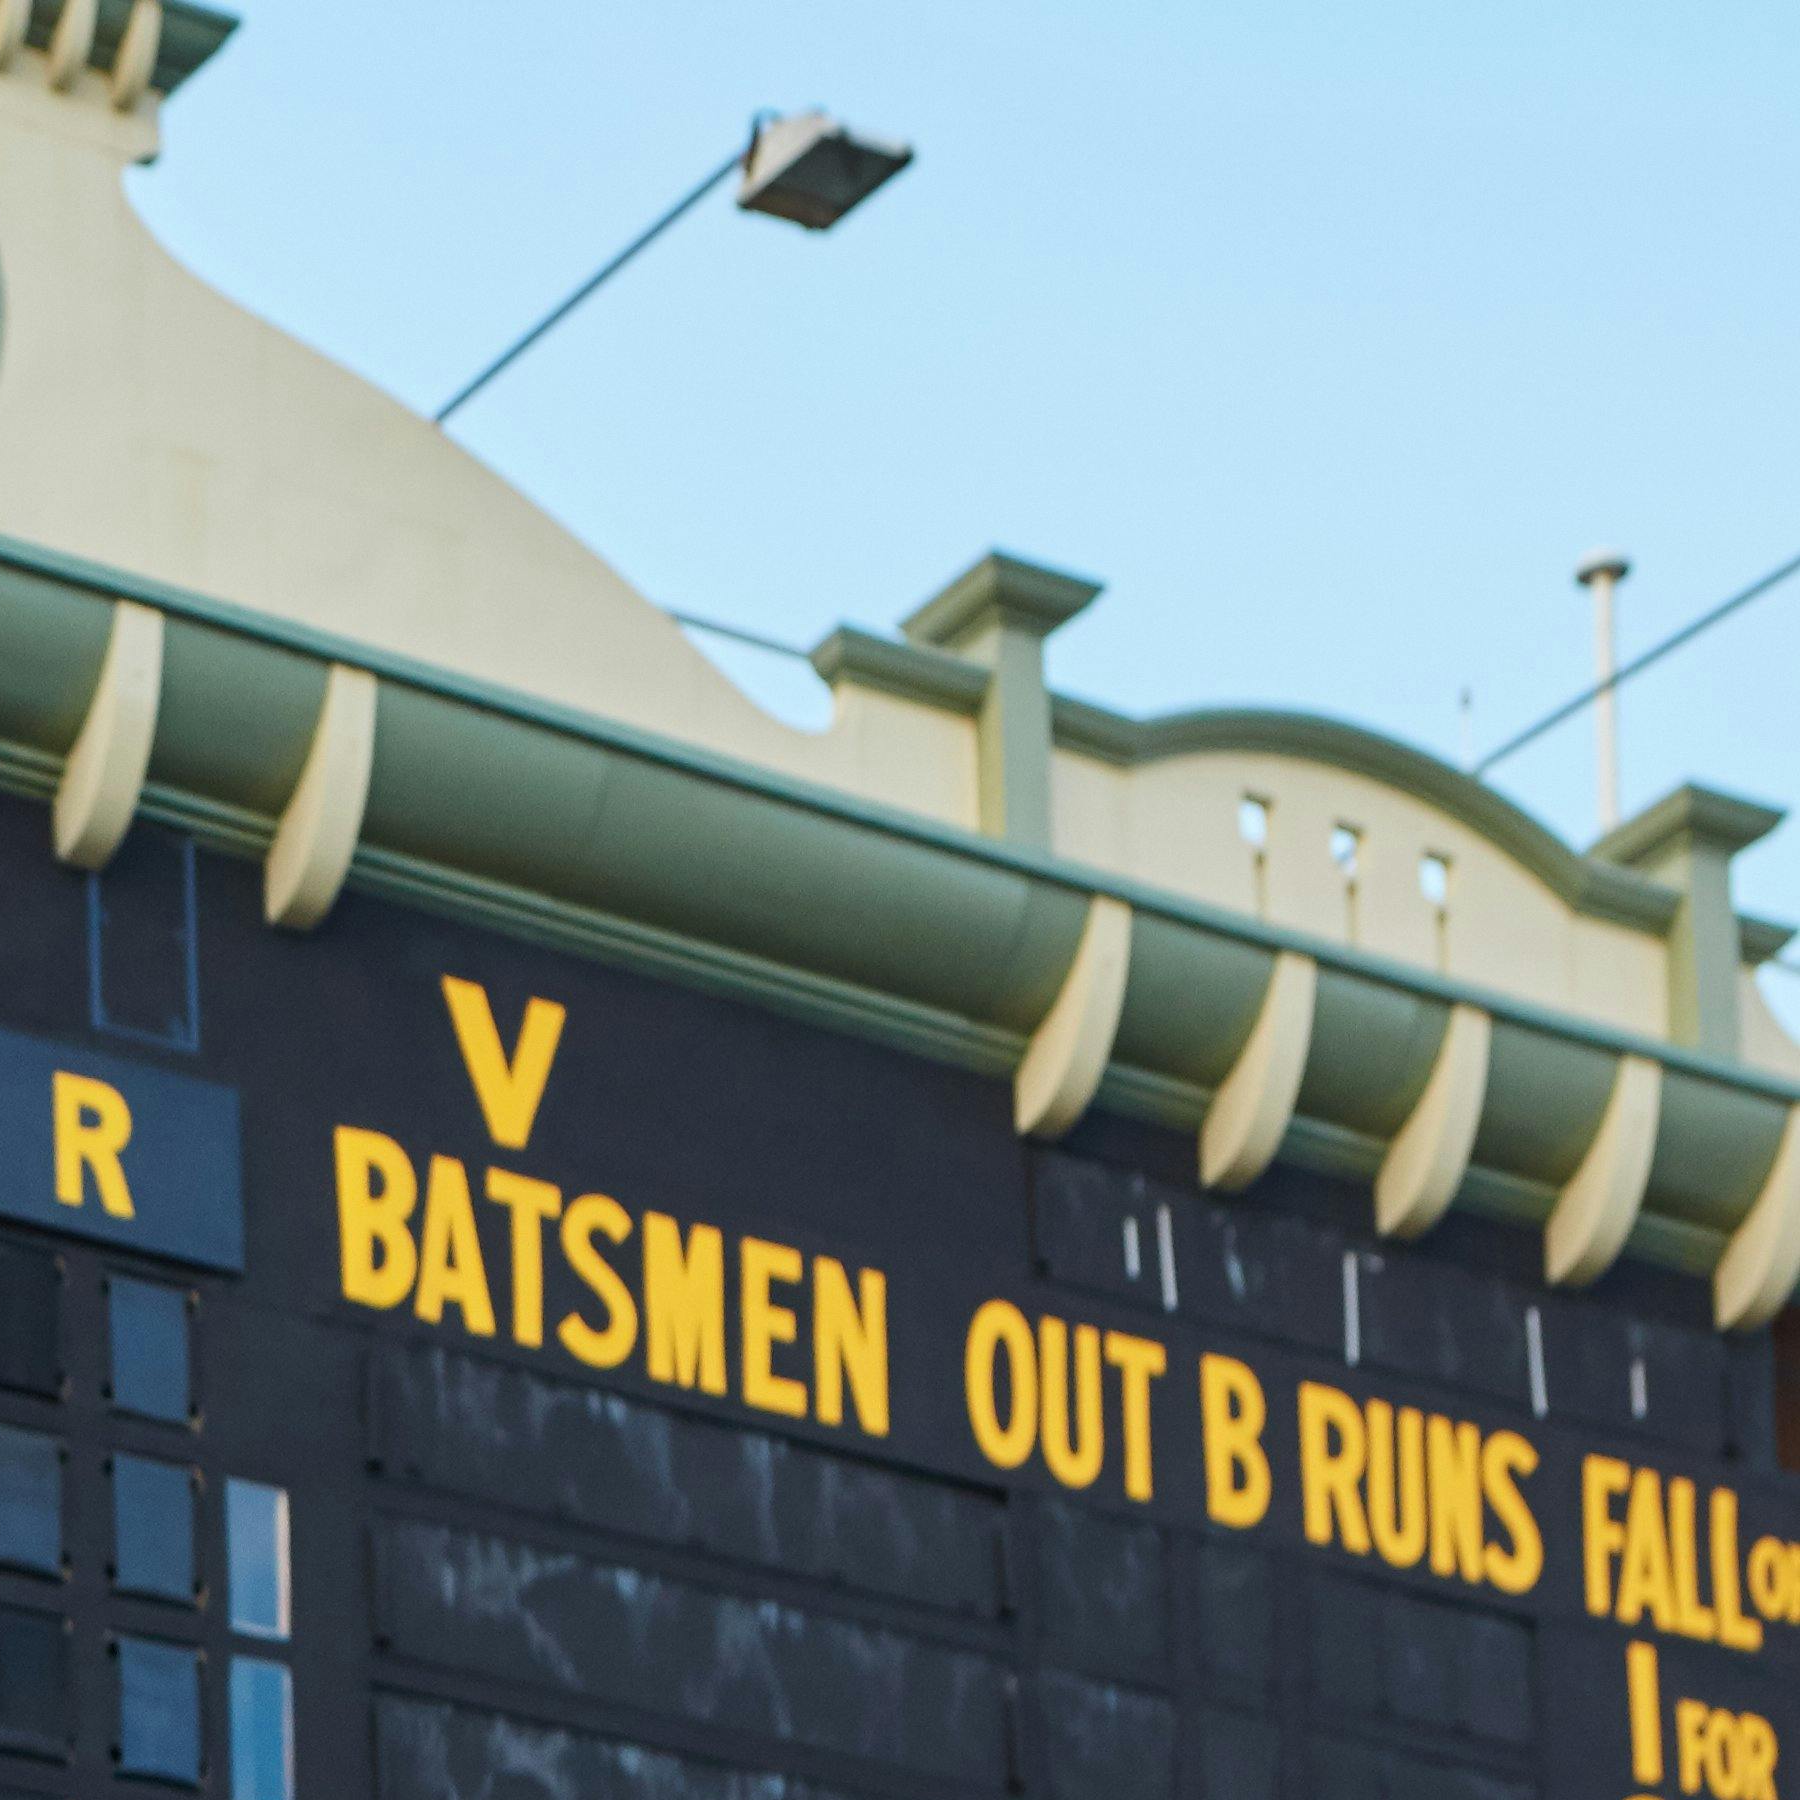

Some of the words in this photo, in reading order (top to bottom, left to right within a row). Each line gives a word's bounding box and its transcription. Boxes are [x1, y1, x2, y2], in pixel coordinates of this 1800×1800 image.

[441, 975, 566, 1149] V
[52, 1070, 137, 1219] R
[333, 1126, 890, 1436] BATSMEN
[964, 1299, 1166, 1501] OUT
[1199, 1353, 1271, 1527] B
[1297, 1381, 1543, 1594] RUNS
[1582, 1454, 1762, 1651] FALL
[1626, 1641, 1662, 1784] 1
